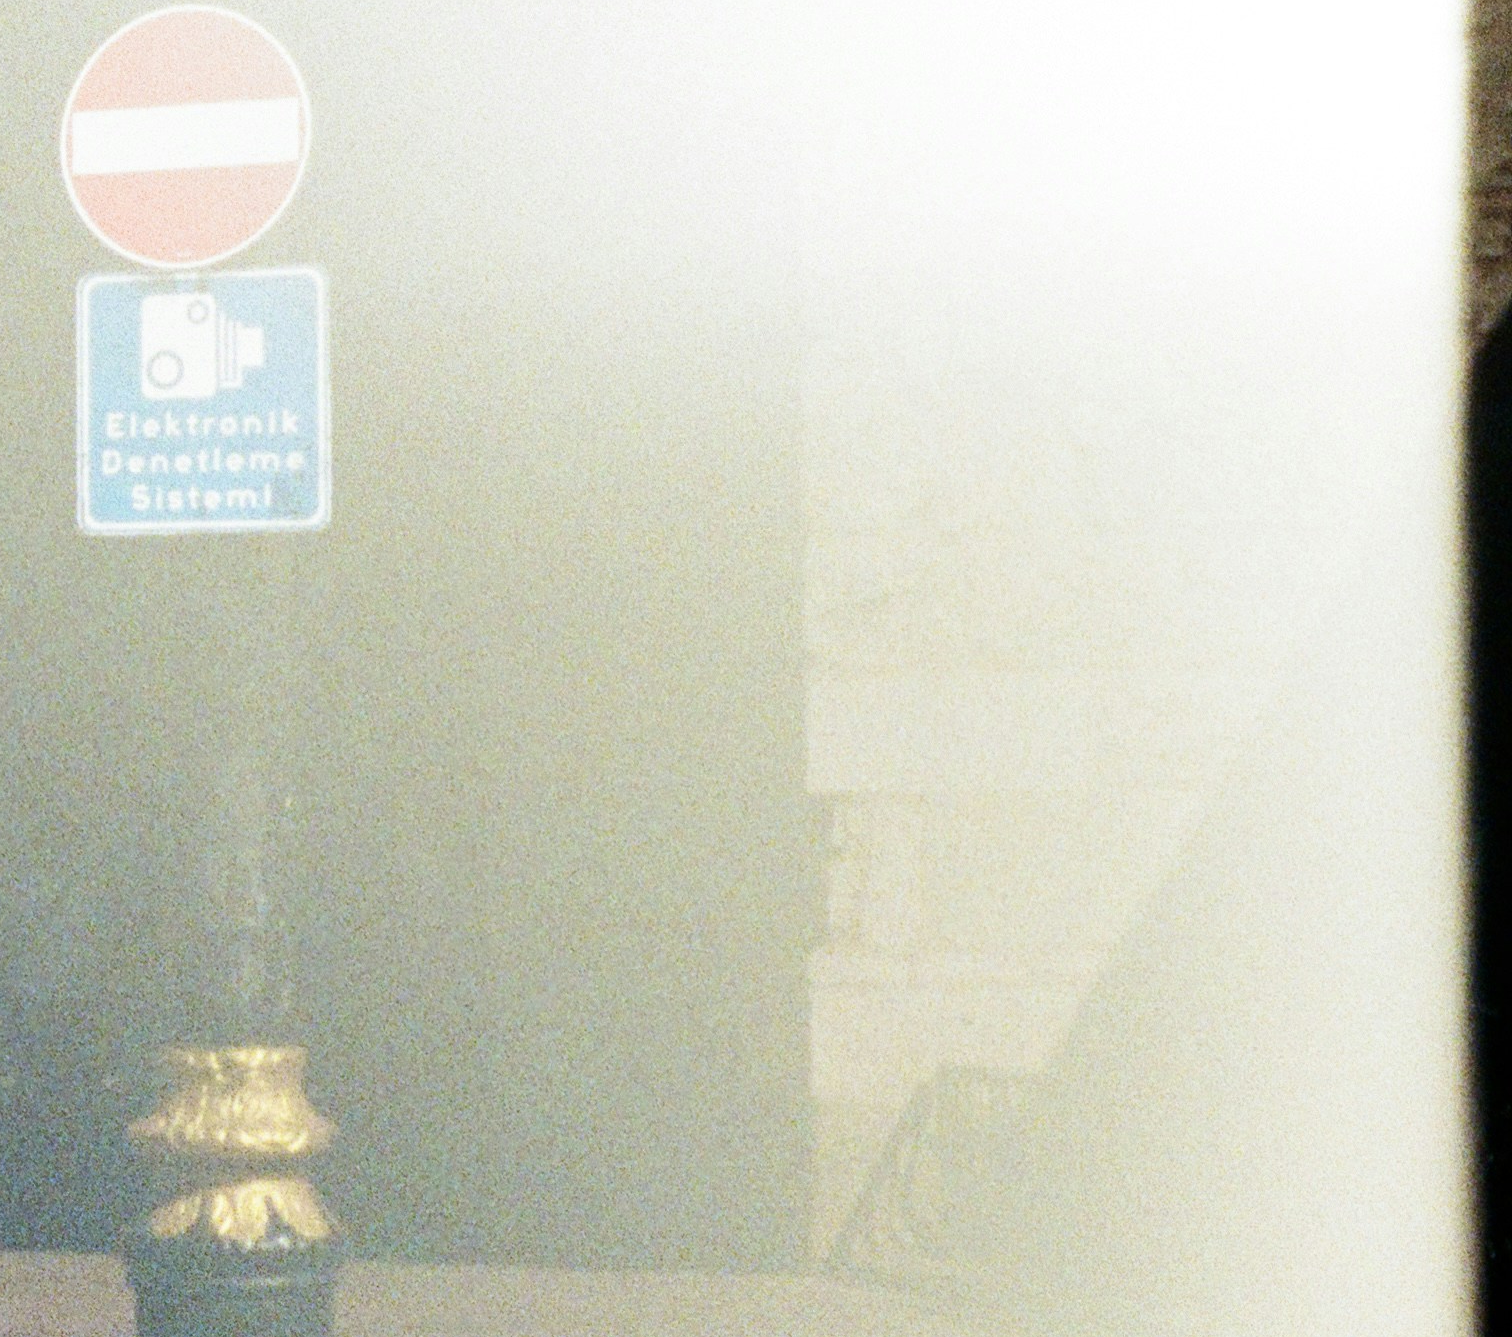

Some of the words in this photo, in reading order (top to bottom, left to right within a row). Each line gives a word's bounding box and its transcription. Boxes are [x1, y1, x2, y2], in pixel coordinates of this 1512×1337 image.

[105, 409, 300, 438] Elektronik
[101, 448, 305, 474] Denetleme
[131, 483, 273, 511] Sistemi
